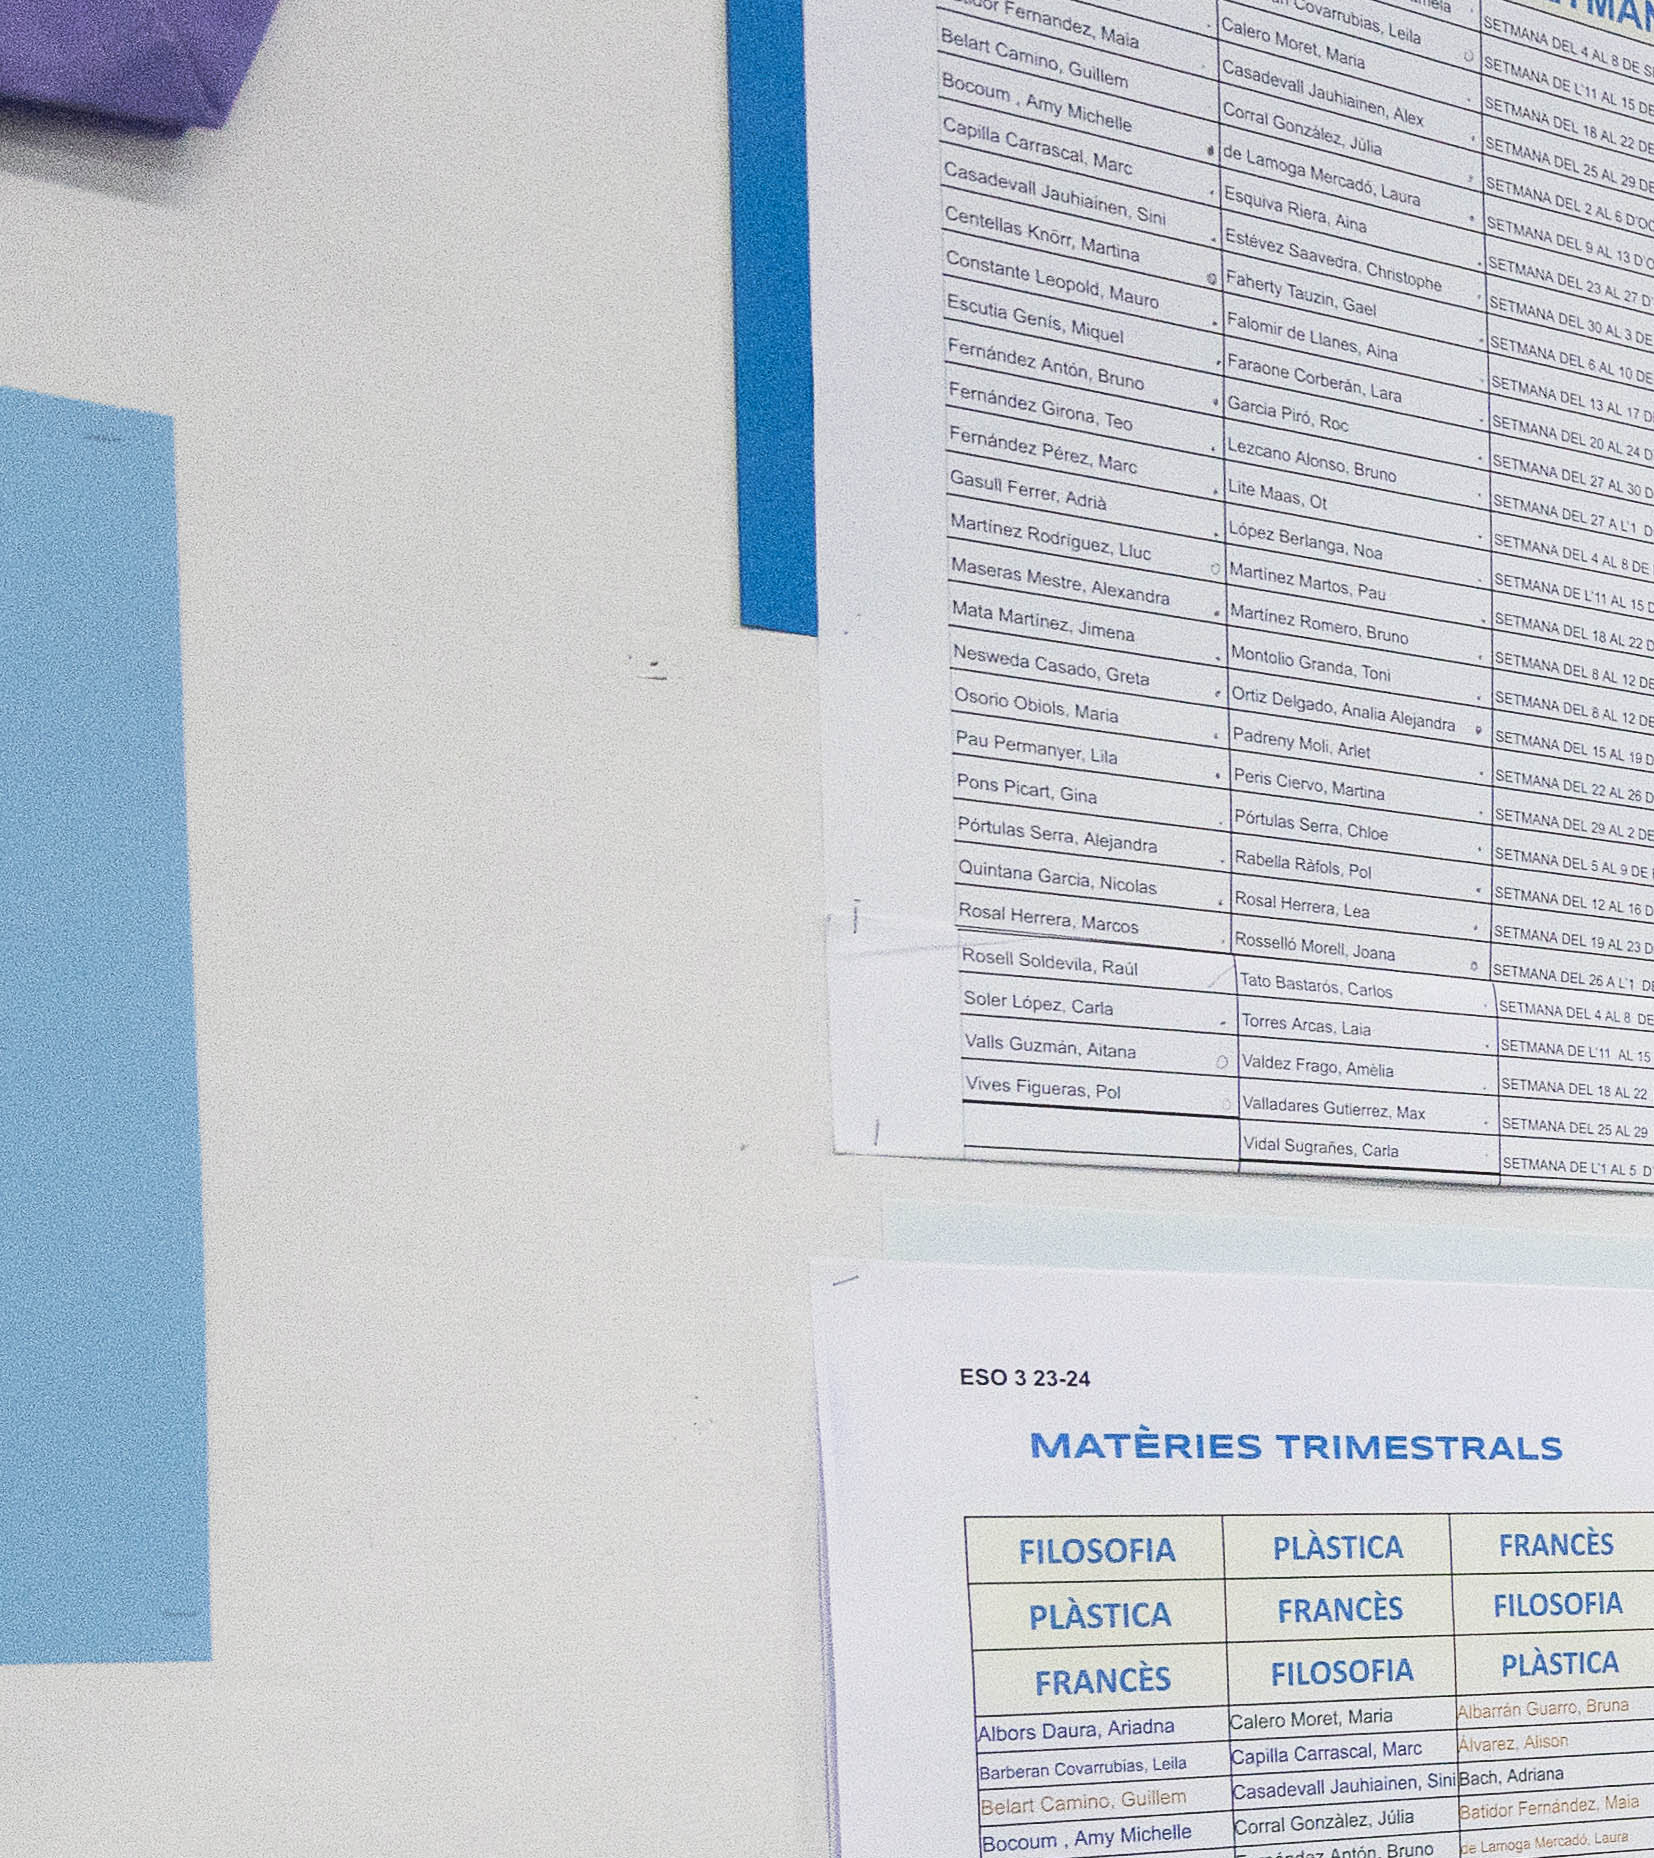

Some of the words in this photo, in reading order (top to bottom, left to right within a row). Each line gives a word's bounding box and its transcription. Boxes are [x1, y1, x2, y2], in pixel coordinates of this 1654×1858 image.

[1484, 15, 1548, 46] SETMANA
[1552, 37, 1576, 55] DEL
[1581, 46, 1588, 58] 4
[1592, 50, 1608, 64] AL
[1612, 54, 1618, 66] 8
[1623, 58, 1639, 74] DE
[951, 469, 1002, 492] Gasull
[1008, 479, 1060, 504] Ferrer,
[1065, 488, 1107, 511] Adrià
[1502, 1156, 1563, 1176] SETMANA
[1568, 1162, 1584, 1176] DE
[1609, 1165, 1625, 1179] AL
[1627, 1166, 1636, 1179] 5
[960, 1369, 1006, 1387] ESO
[1014, 1369, 1027, 1387] 3
[1032, 1370, 1090, 1389] 23-24
[1030, 1423, 1262, 1460] MATÈRIES
[1275, 1433, 1563, 1462] TRIMESTRALS
[1019, 1537, 1176, 1566] FILOSOFIA
[1274, 1528, 1403, 1561] PLÀSTICA
[1500, 1529, 1614, 1558] FRANCÈS
[1029, 1597, 1172, 1631] PLÀSTICA
[1277, 1593, 1403, 1624] FRANCÈS
[1494, 1589, 1623, 1617] FILOSOFIA
[1271, 1657, 1414, 1687] FILOSOFIA
[1501, 1647, 1619, 1678] PLÀSTICA
[1035, 1662, 1172, 1696] FRANCÈS
[979, 1722, 1036, 1743] Albors
[1042, 1720, 1102, 1743] Daura,
[1109, 1716, 1175, 1738] Ariadna
[1230, 1711, 1286, 1732] Calero
[1290, 1708, 1343, 1731] Moret,
[1347, 1707, 1393, 1726] Maria
